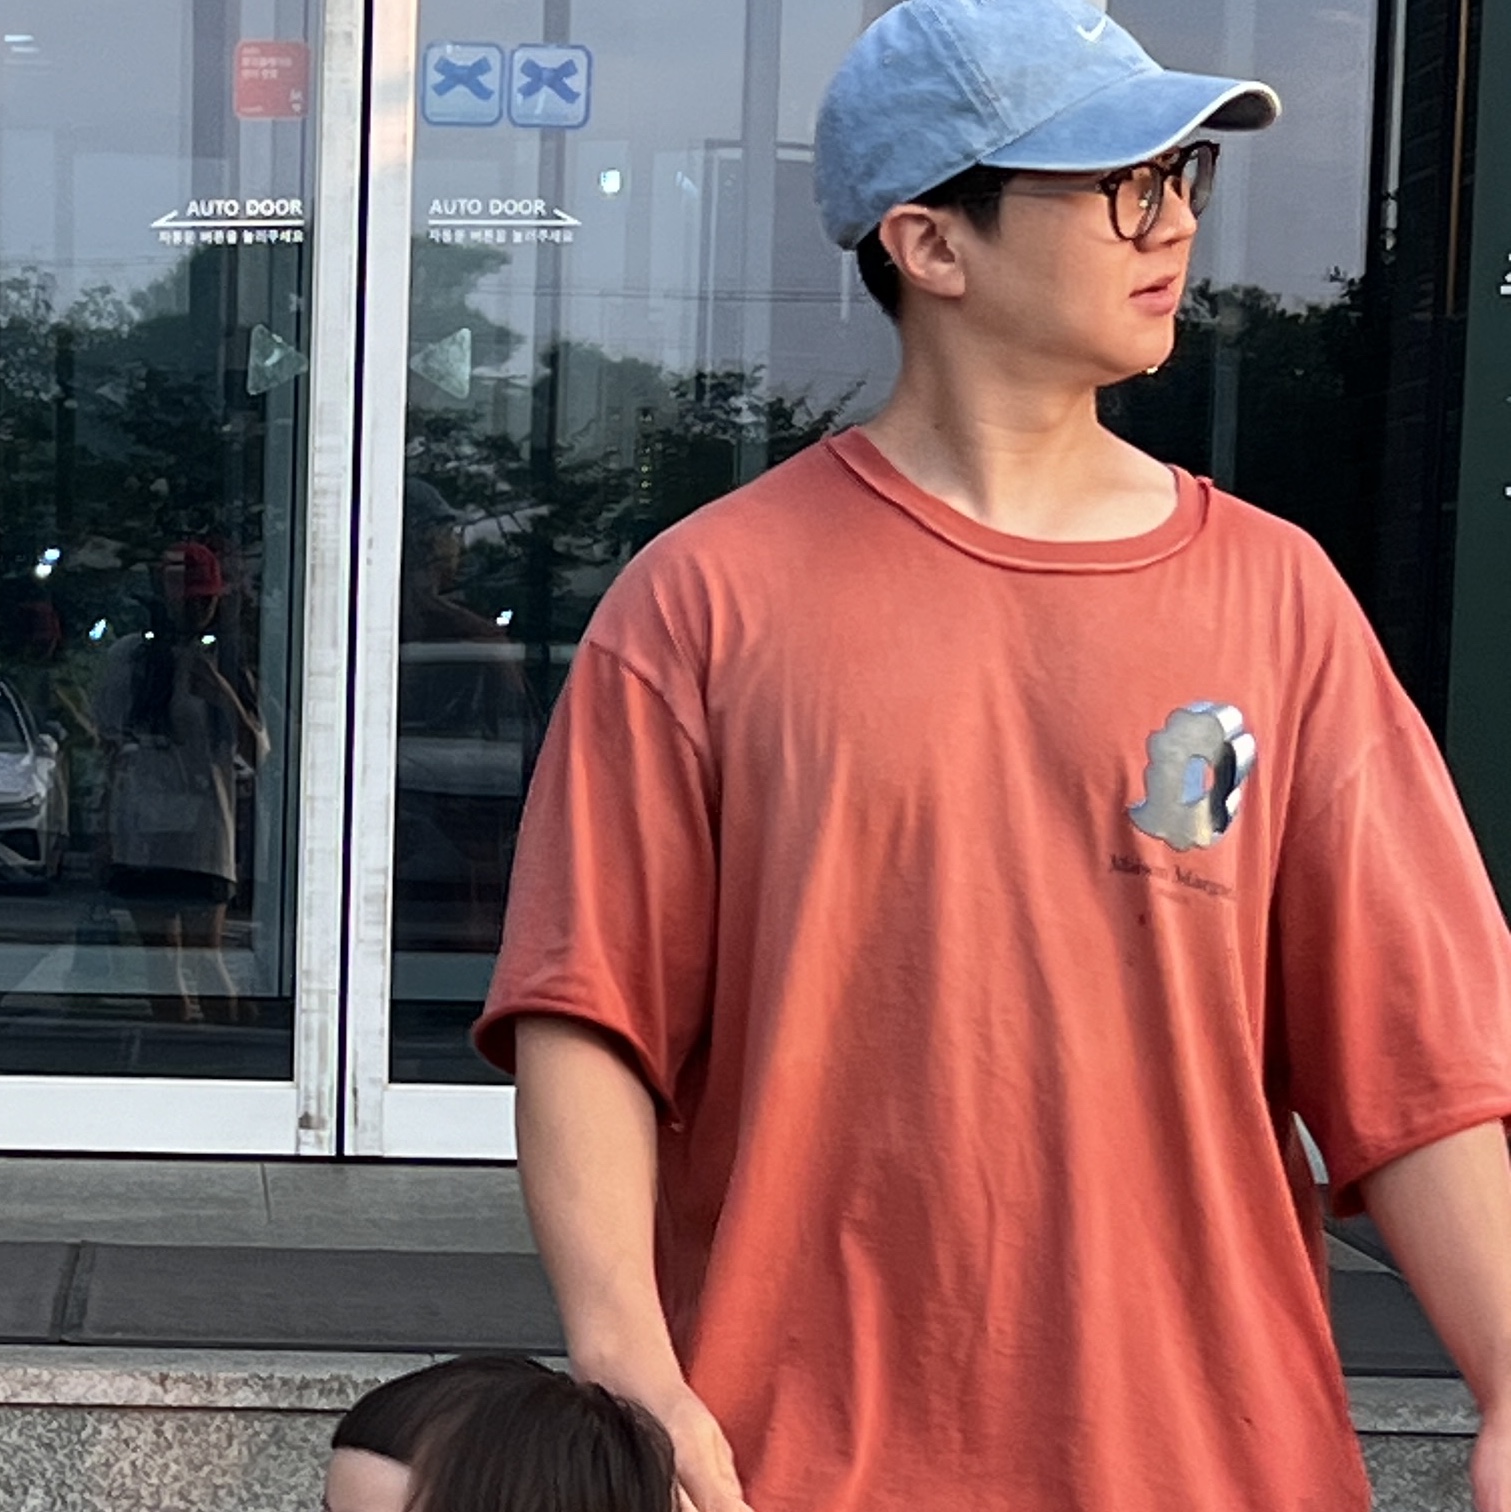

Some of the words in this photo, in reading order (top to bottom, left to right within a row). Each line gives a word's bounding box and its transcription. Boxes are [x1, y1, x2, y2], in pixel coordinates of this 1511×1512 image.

[186, 199, 239, 217] AUTO
[245, 199, 303, 217] DOOR
[428, 199, 482, 216] AUTO
[489, 199, 547, 216] DOOR
